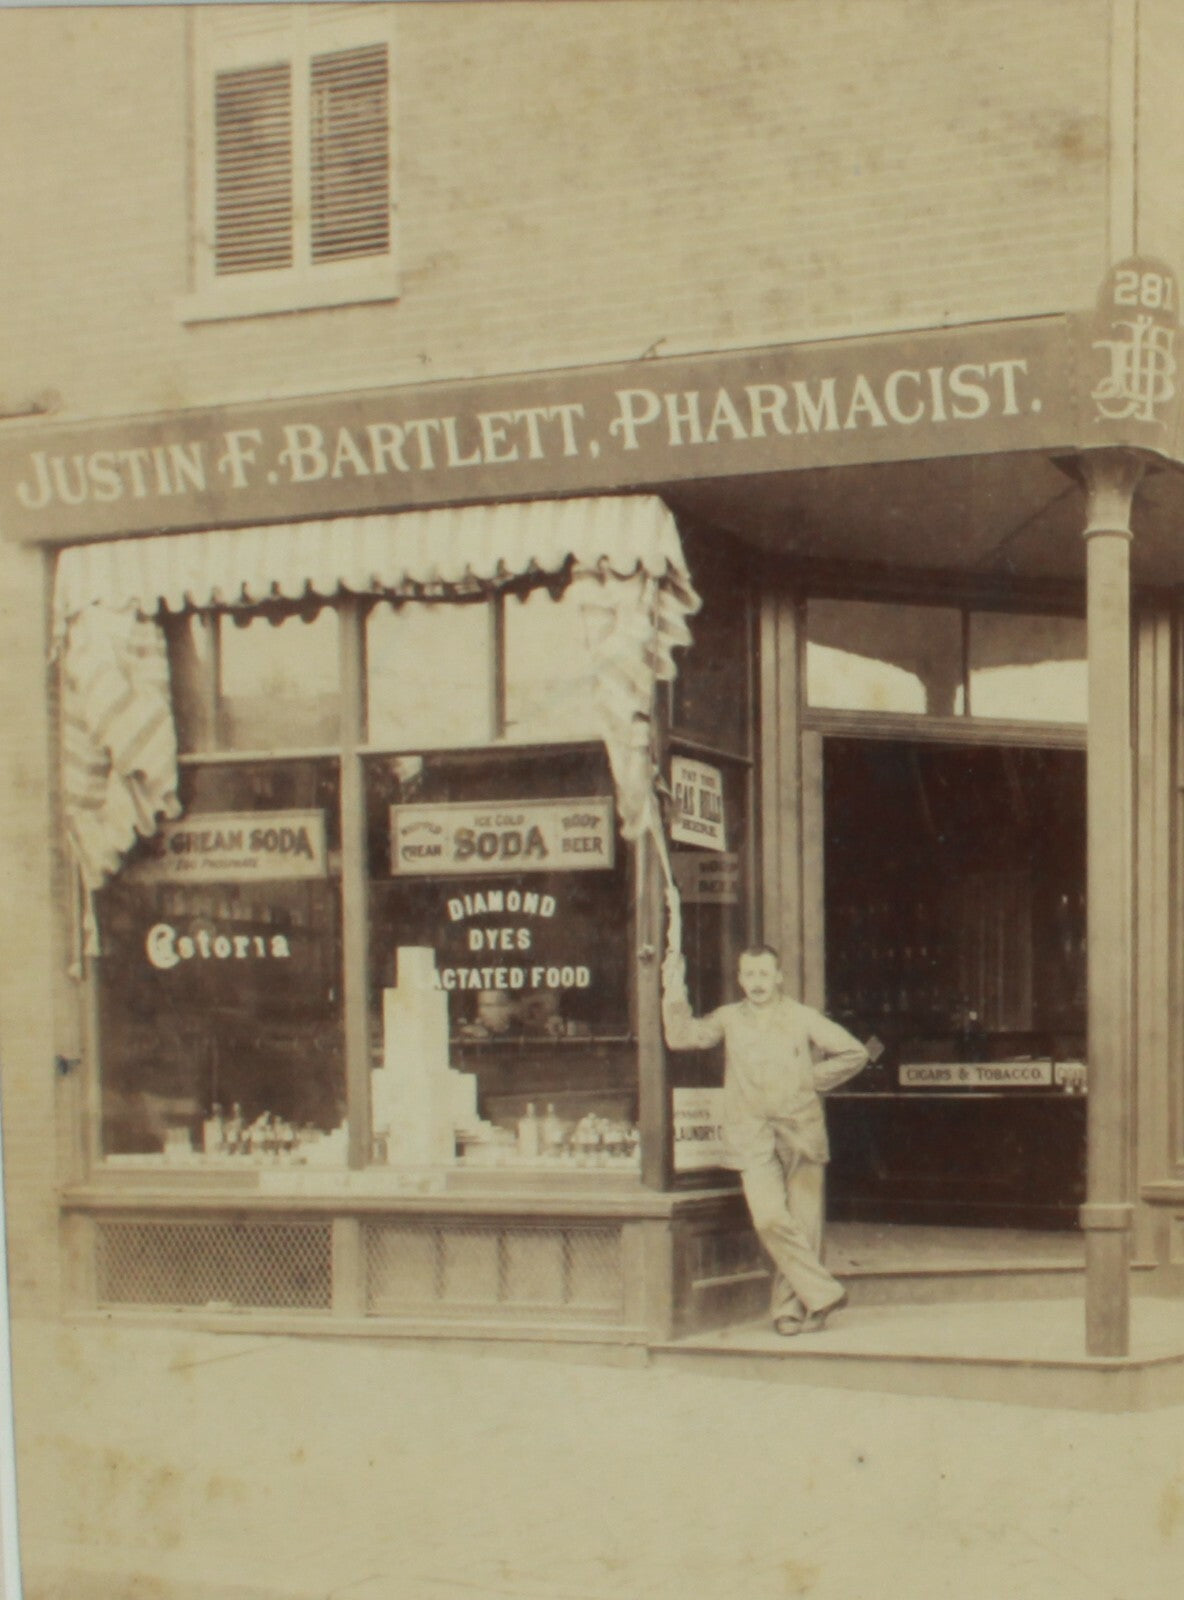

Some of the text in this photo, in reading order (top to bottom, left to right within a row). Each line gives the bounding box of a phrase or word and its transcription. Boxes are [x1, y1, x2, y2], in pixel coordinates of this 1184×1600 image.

[16, 441, 207, 510] JUSTIN
[249, 826, 315, 860] SODA
[454, 826, 549, 862] SODA
[562, 837, 604, 855] BEER
[448, 890, 556, 921] DIAMOND
[469, 927, 532, 950] DYES
[433, 965, 591, 990] ACTATED FOOD
